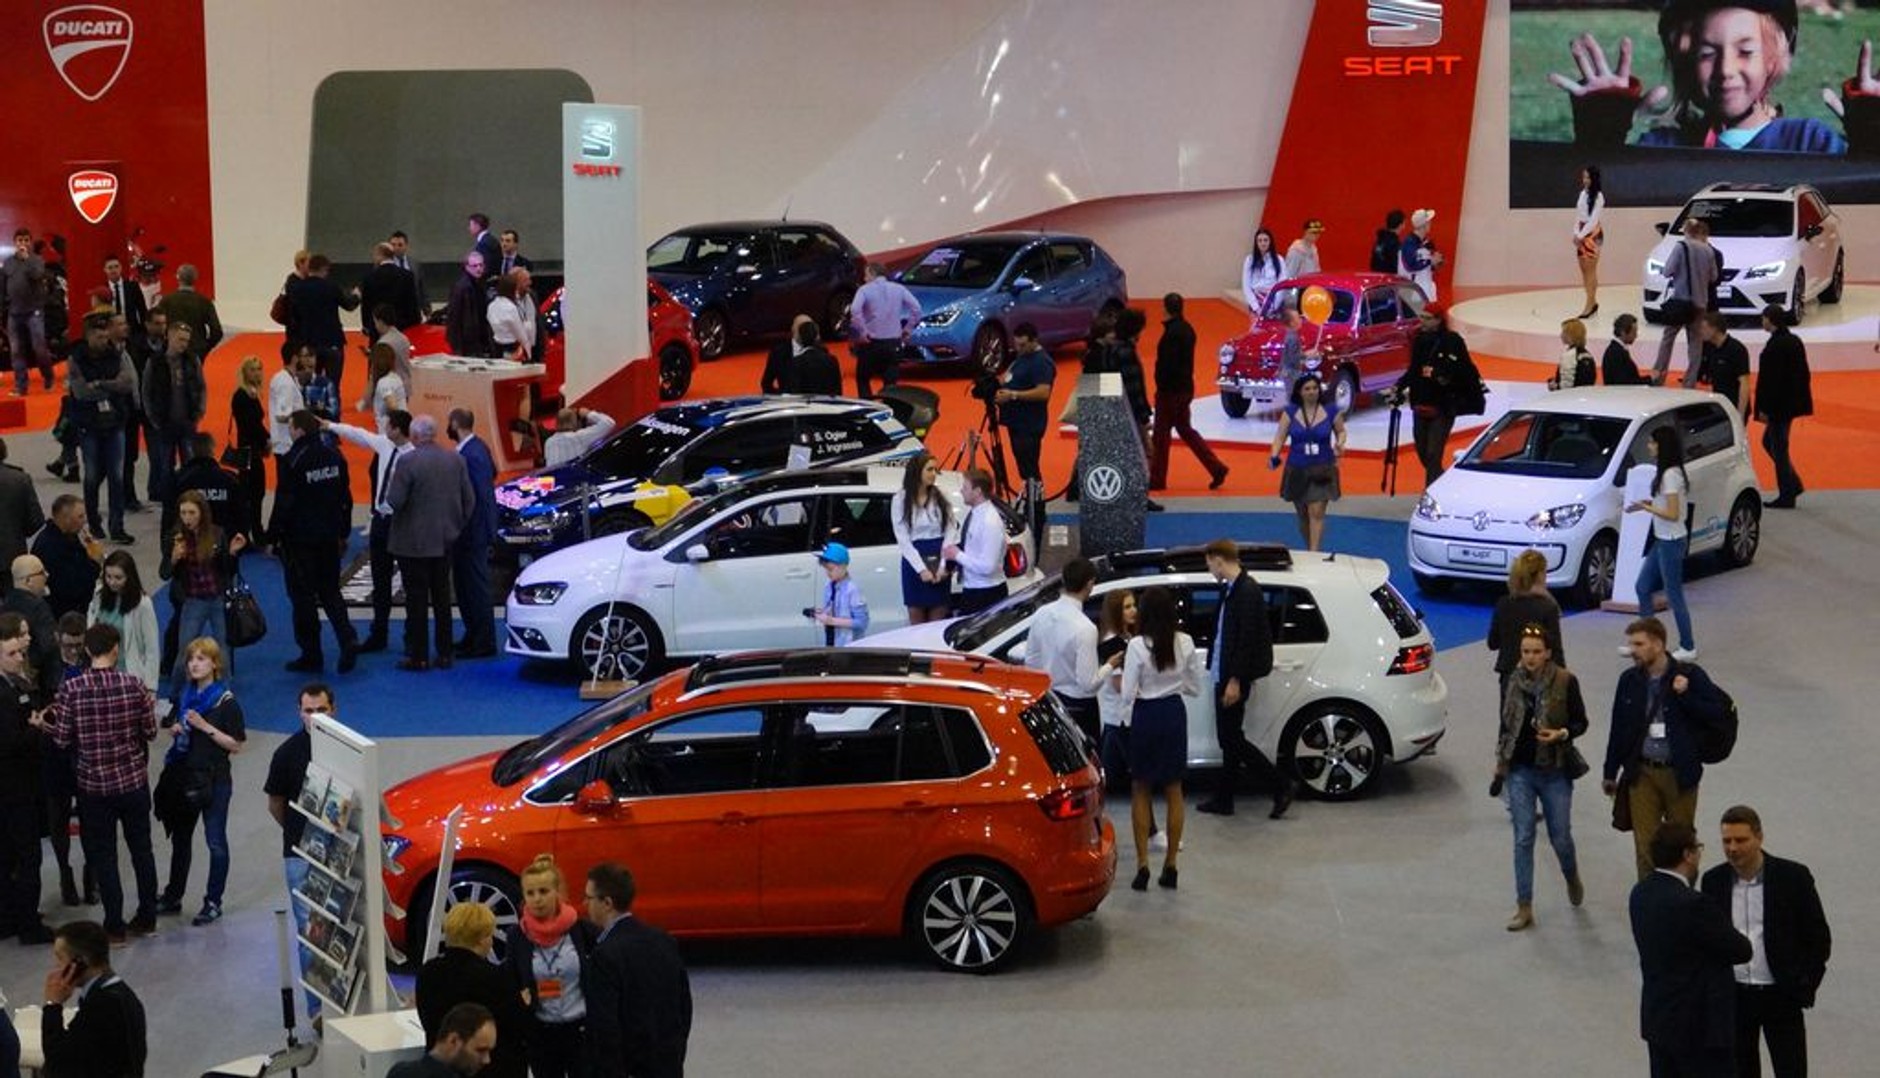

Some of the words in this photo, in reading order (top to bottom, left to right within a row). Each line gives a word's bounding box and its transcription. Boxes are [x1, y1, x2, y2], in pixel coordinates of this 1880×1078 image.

[53, 21, 122, 37] DUCATI
[1345, 56, 1462, 76] SEAT
[573, 163, 621, 178] SEAT
[74, 179, 112, 189] DUCATI
[814, 433, 823, 442] S.
[825, 430, 848, 442] Ogier
[817, 445, 825, 454] J.
[305, 466, 339, 485] POLICJA
